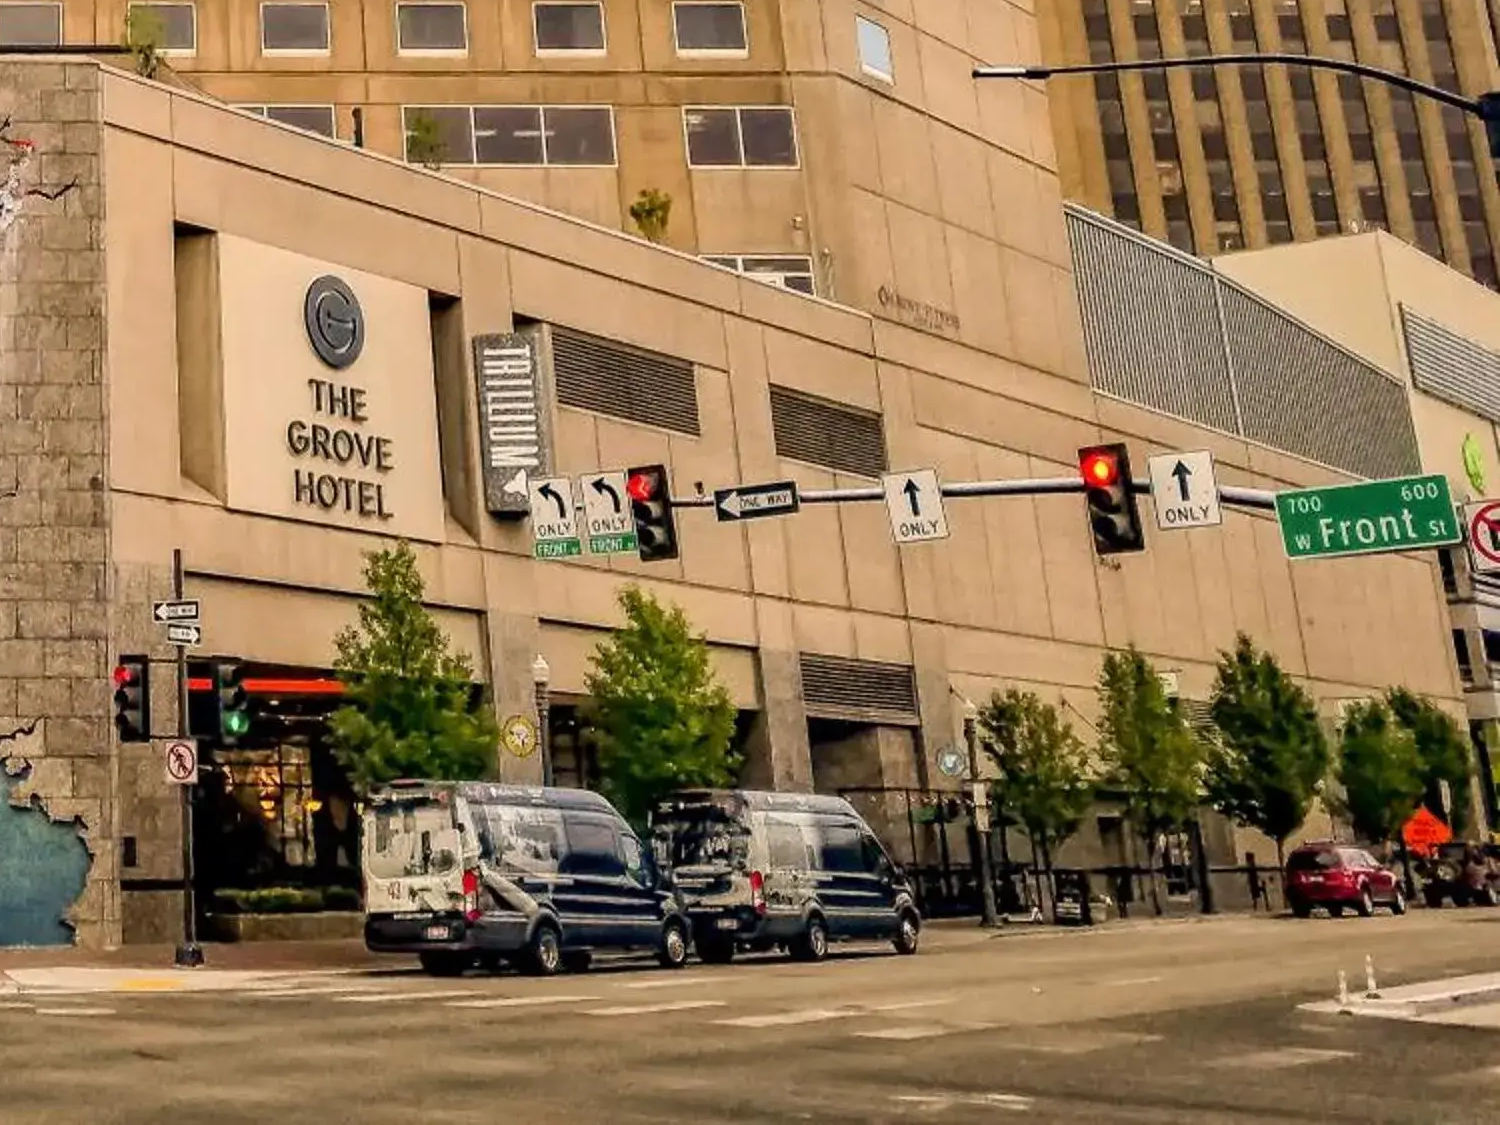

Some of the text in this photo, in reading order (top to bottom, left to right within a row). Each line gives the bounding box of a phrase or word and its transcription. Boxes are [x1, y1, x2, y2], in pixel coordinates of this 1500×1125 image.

[308, 378, 368, 421] THE
[483, 344, 539, 467] TRILLIUM
[287, 420, 394, 471] GROVE
[294, 469, 394, 519] HOTEL
[1288, 482, 1438, 514] 700 600
[538, 522, 571, 537] ONLY
[591, 518, 625, 532] ONLY
[900, 522, 939, 537] ONLY
[1165, 505, 1210, 523] ONLY
[1319, 508, 1417, 548] Front
[1429, 519, 1448, 536] St
